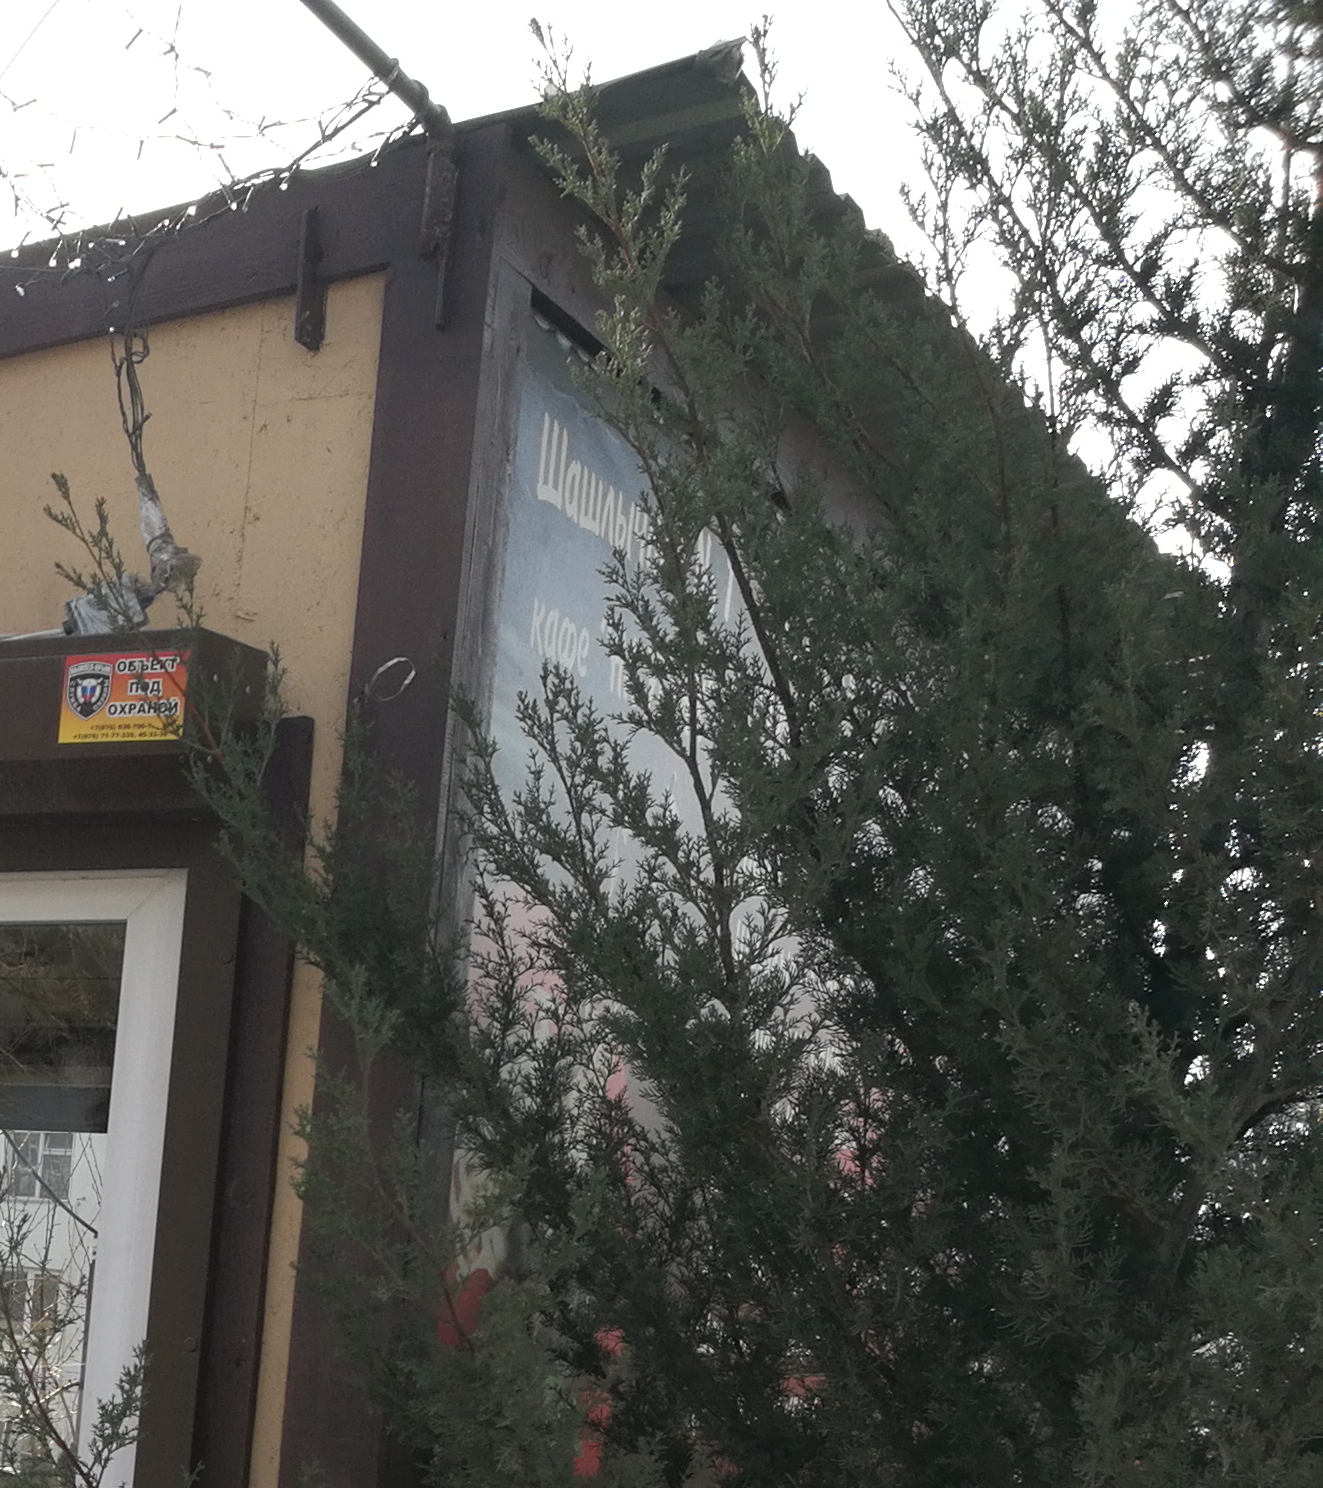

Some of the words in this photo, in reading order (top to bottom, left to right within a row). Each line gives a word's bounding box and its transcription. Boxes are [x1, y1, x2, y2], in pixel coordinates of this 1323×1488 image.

[116, 657, 179, 673] ОБЪЕКТ
[127, 679, 162, 696] ПОД
[106, 697, 180, 717] ОХРАНОЙ
